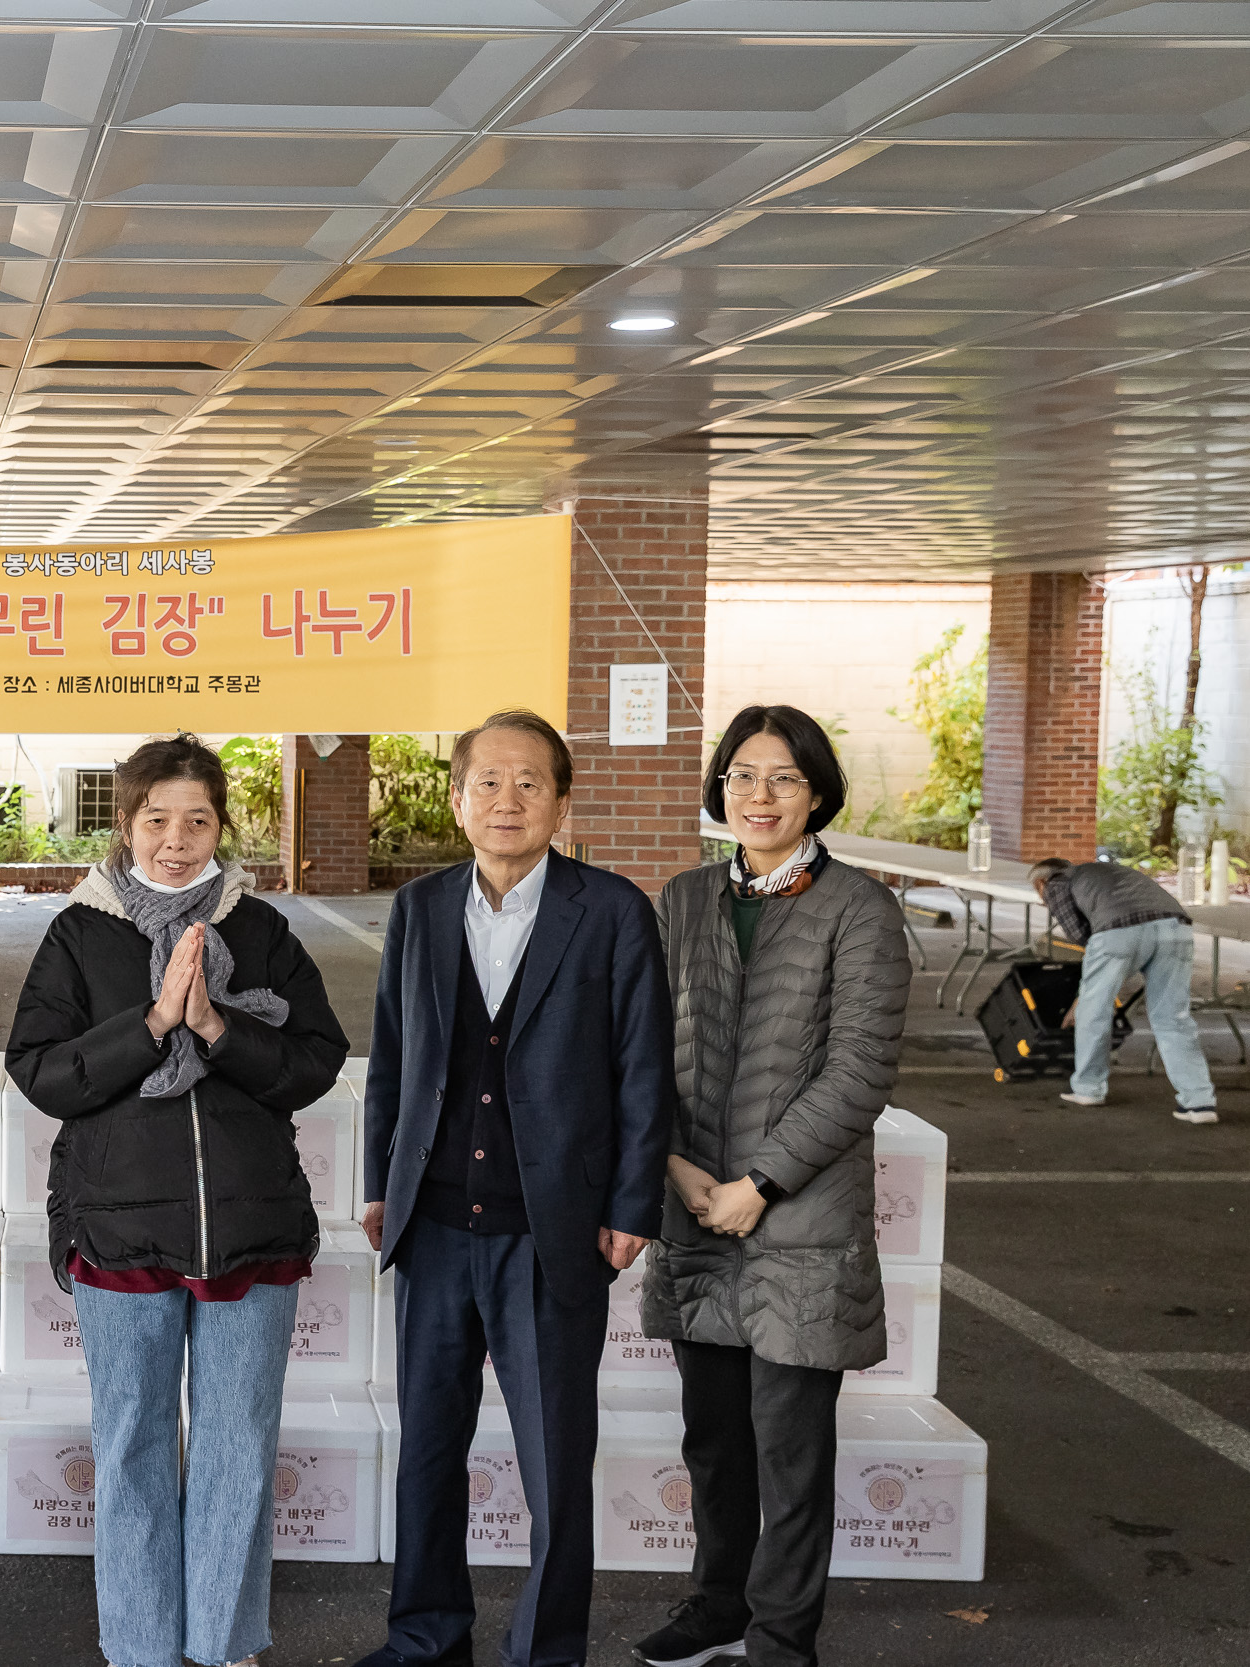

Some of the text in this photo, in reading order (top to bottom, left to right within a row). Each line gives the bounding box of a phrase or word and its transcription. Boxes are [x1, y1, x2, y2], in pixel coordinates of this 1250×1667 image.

[2, 551, 129, 577] 봉사동아리
[138, 549, 215, 575] 세사봉
[101, 591, 225, 658] 김장"
[261, 587, 412, 656] 나누기
[3, 676, 38, 694] 장소
[57, 675, 200, 694] 세종사이버대학교
[208, 675, 261, 694] 주몽관
[622, 1347, 673, 1359] 김장 나누
[32, 1499, 82, 1512] 사랑으로
[288, 1508, 325, 1520] 버무린
[482, 1512, 520, 1524] 버무린
[47, 1515, 72, 1528] 김장
[628, 1520, 679, 1532] 사랑으로
[277, 1524, 314, 1536] 나누기
[472, 1528, 509, 1540] 나누기
[643, 1536, 697, 1549] 김장 나누
